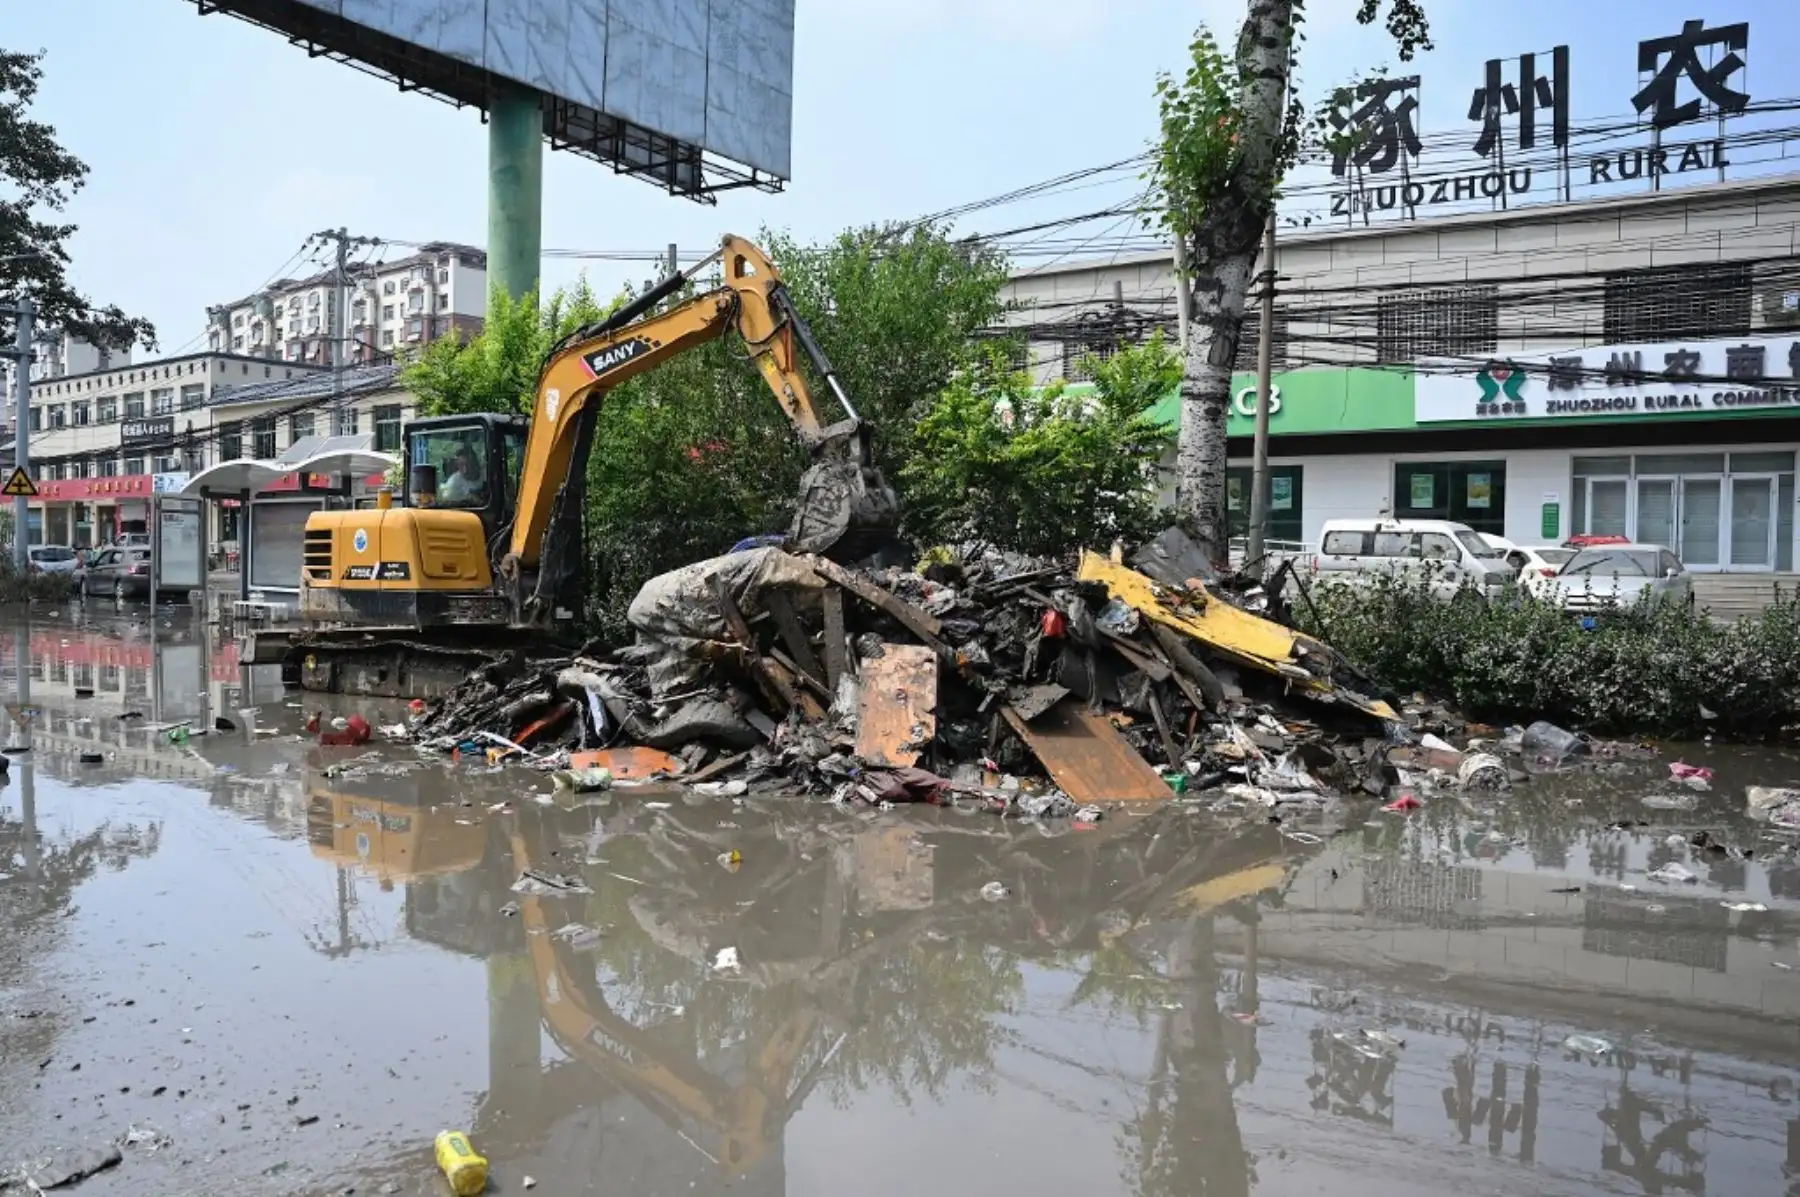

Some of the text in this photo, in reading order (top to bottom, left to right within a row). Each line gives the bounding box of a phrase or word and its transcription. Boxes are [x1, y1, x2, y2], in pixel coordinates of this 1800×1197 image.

[1330, 141, 1730, 217] ZHUOZHOU RURAL
[593, 340, 635, 372] SANY
[1546, 396, 1637, 413] ZHUOZHOU
[1644, 393, 1702, 410] RURAL
